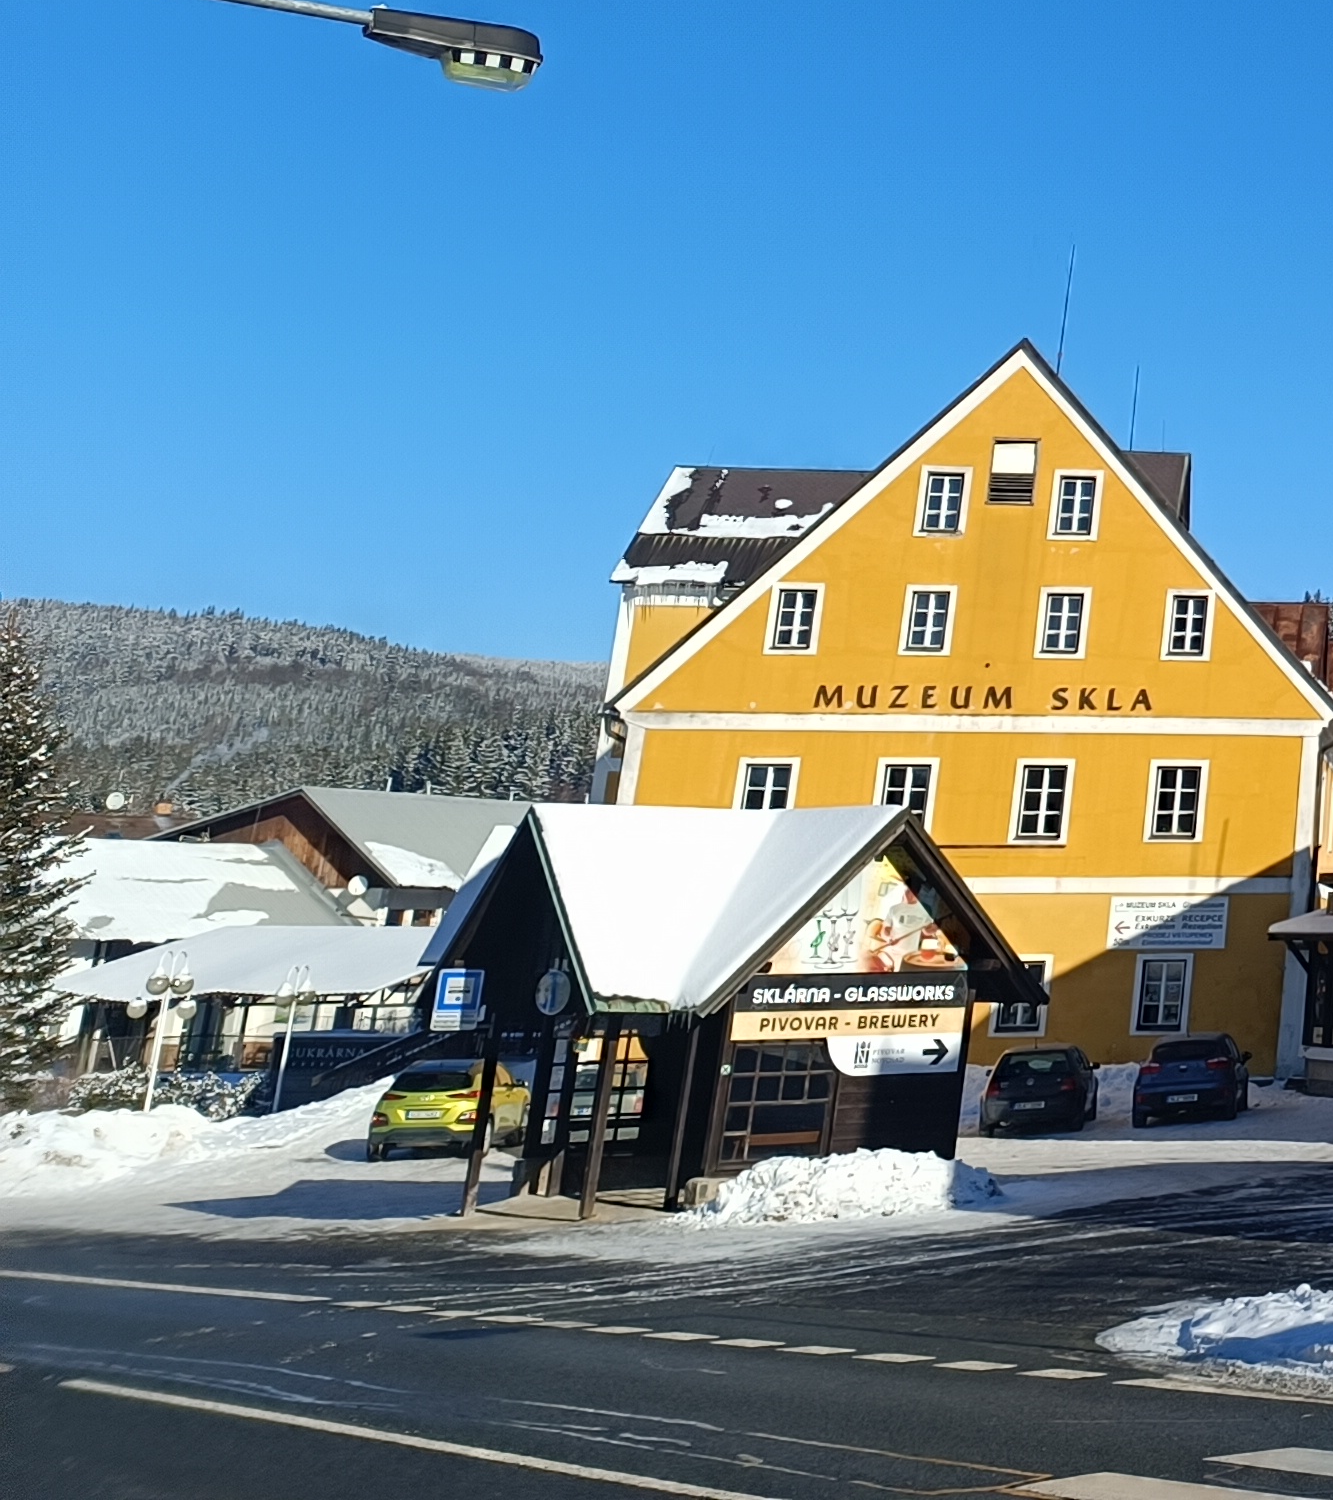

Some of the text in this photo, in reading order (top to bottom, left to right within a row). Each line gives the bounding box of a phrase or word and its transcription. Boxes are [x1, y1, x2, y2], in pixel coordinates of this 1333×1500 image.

[813, 685, 1153, 712] MUZEUM SKLA
[1181, 914, 1224, 922] RECEPCE
[752, 984, 831, 1004] SKLÁRNA
[844, 985, 955, 1002] GLASSWORKS
[759, 1016, 839, 1032] PIVOVAR
[857, 1013, 940, 1030] BREWERY
[290, 1044, 366, 1058] UKRÁRNA
